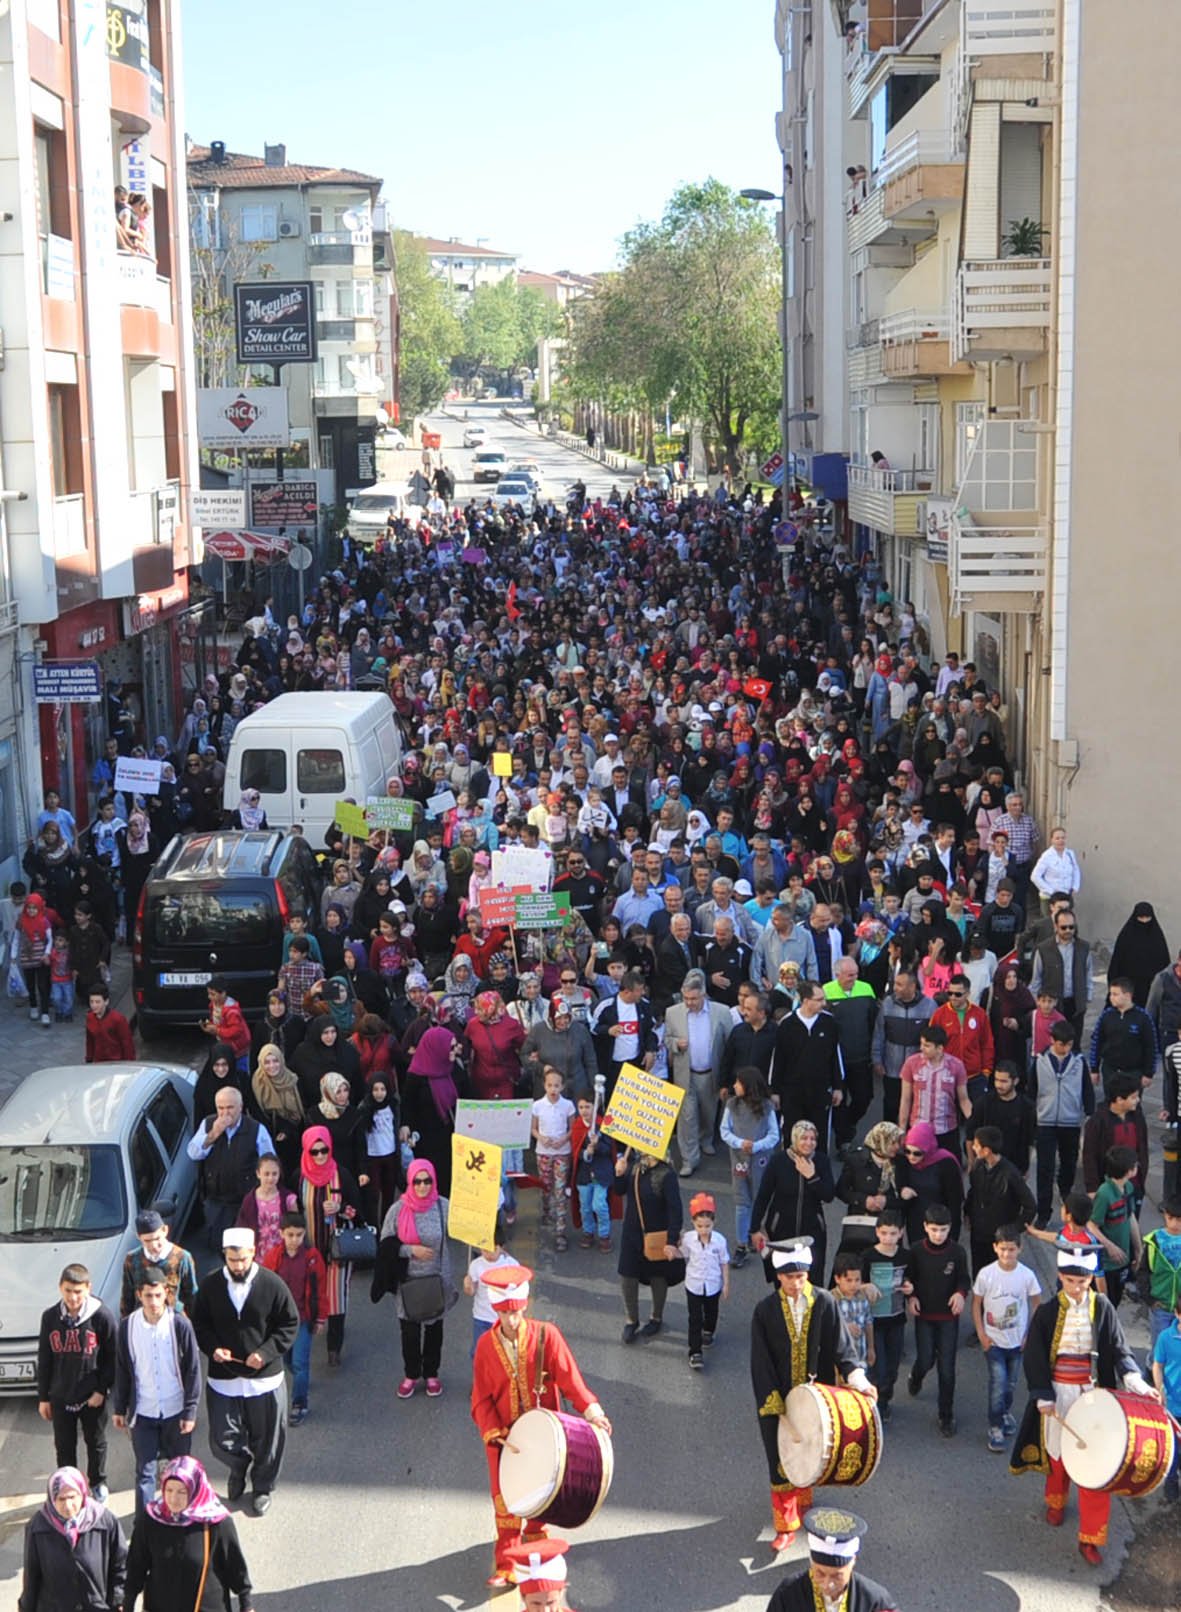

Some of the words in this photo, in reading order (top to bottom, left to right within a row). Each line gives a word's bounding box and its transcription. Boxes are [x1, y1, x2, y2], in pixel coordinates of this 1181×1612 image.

[244, 328, 281, 343] Show
[282, 327, 307, 343] Car
[244, 343, 272, 353] DETAIL
[273, 343, 307, 352] CENTER
[637, 1072, 664, 1089] CANIM
[641, 1098, 675, 1118] YOLUNA
[17, 1364, 33, 1377] 74
